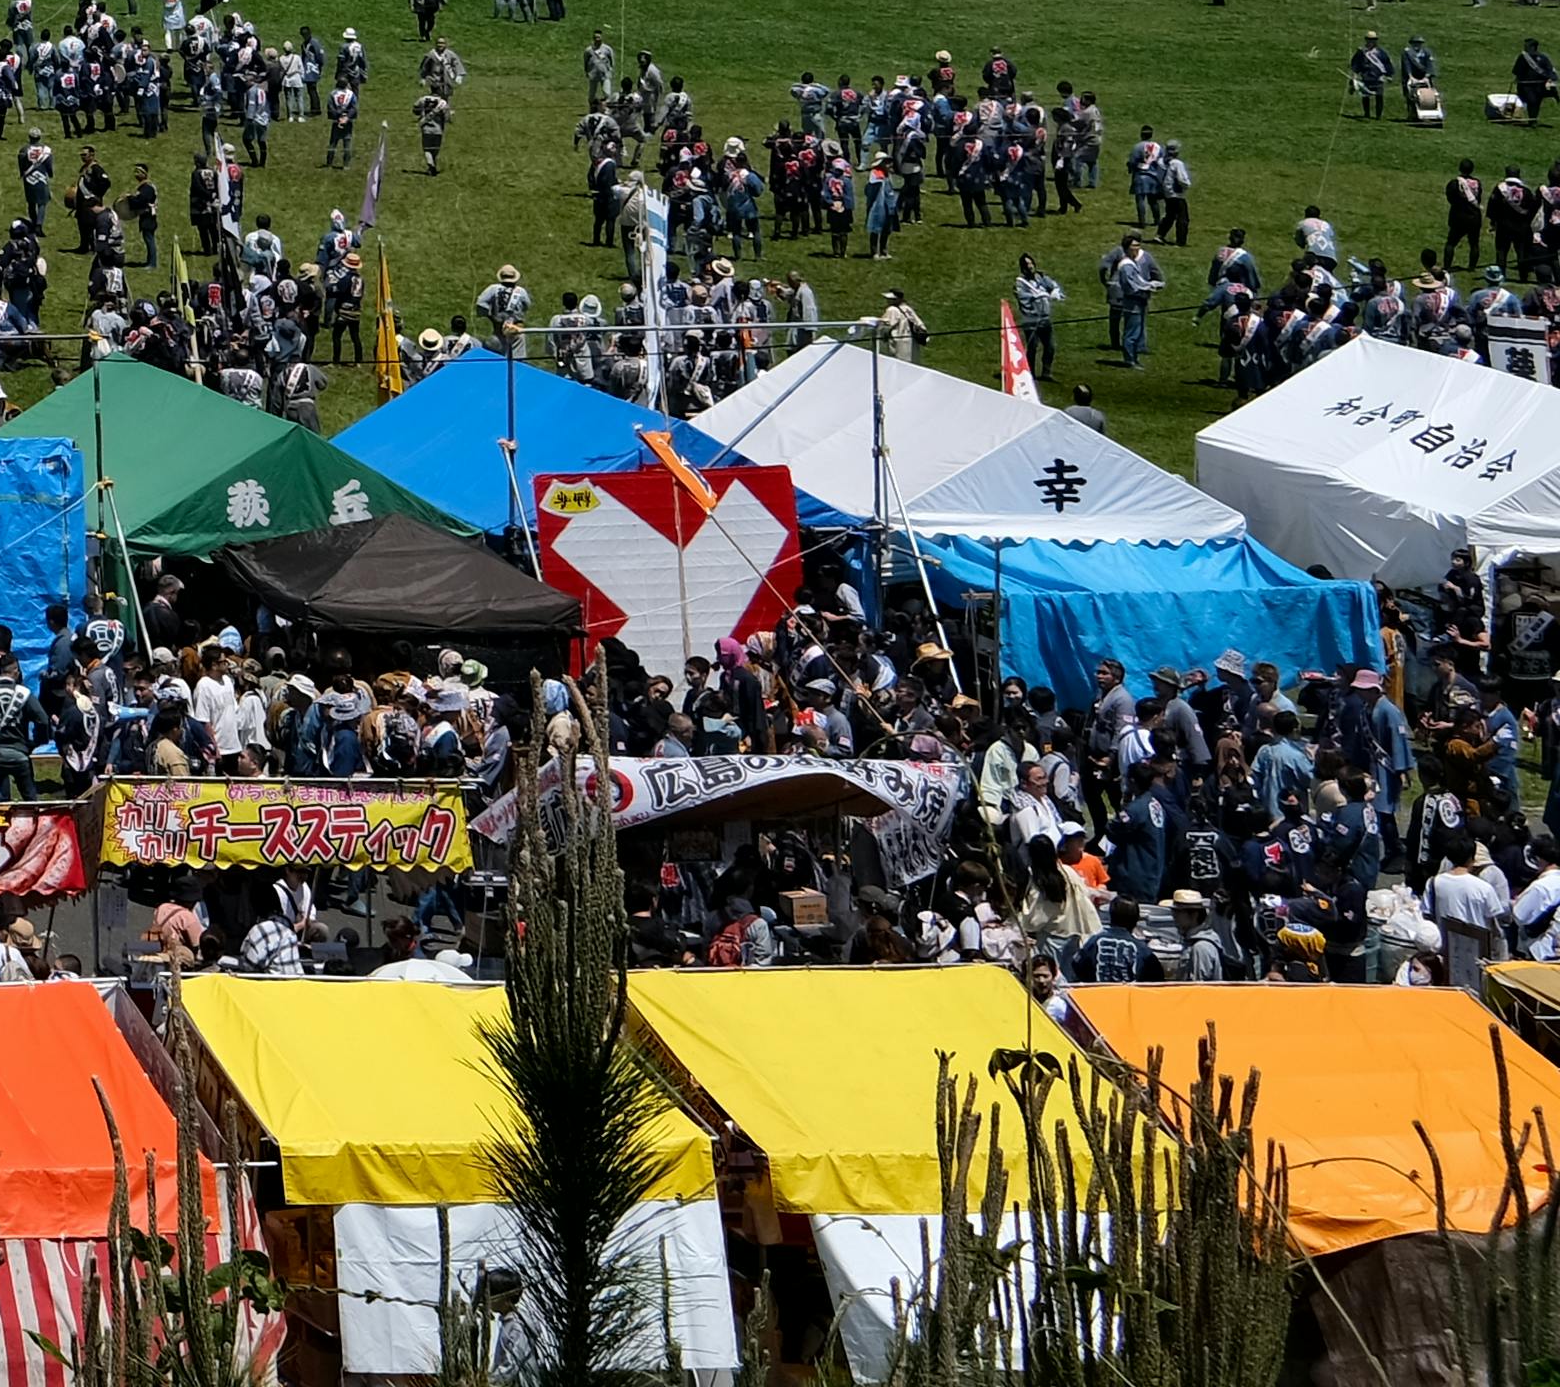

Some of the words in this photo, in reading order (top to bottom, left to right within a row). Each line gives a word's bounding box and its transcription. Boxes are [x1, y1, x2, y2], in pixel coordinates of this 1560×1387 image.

[1324, 395, 1518, 481] 和合町自治会
[227, 478, 373, 527] 萩丘
[1033, 457, 1088, 513] 幸
[117, 802, 170, 831] カリ
[188, 804, 457, 864] チーズスティック
[139, 831, 187, 863] カリ
